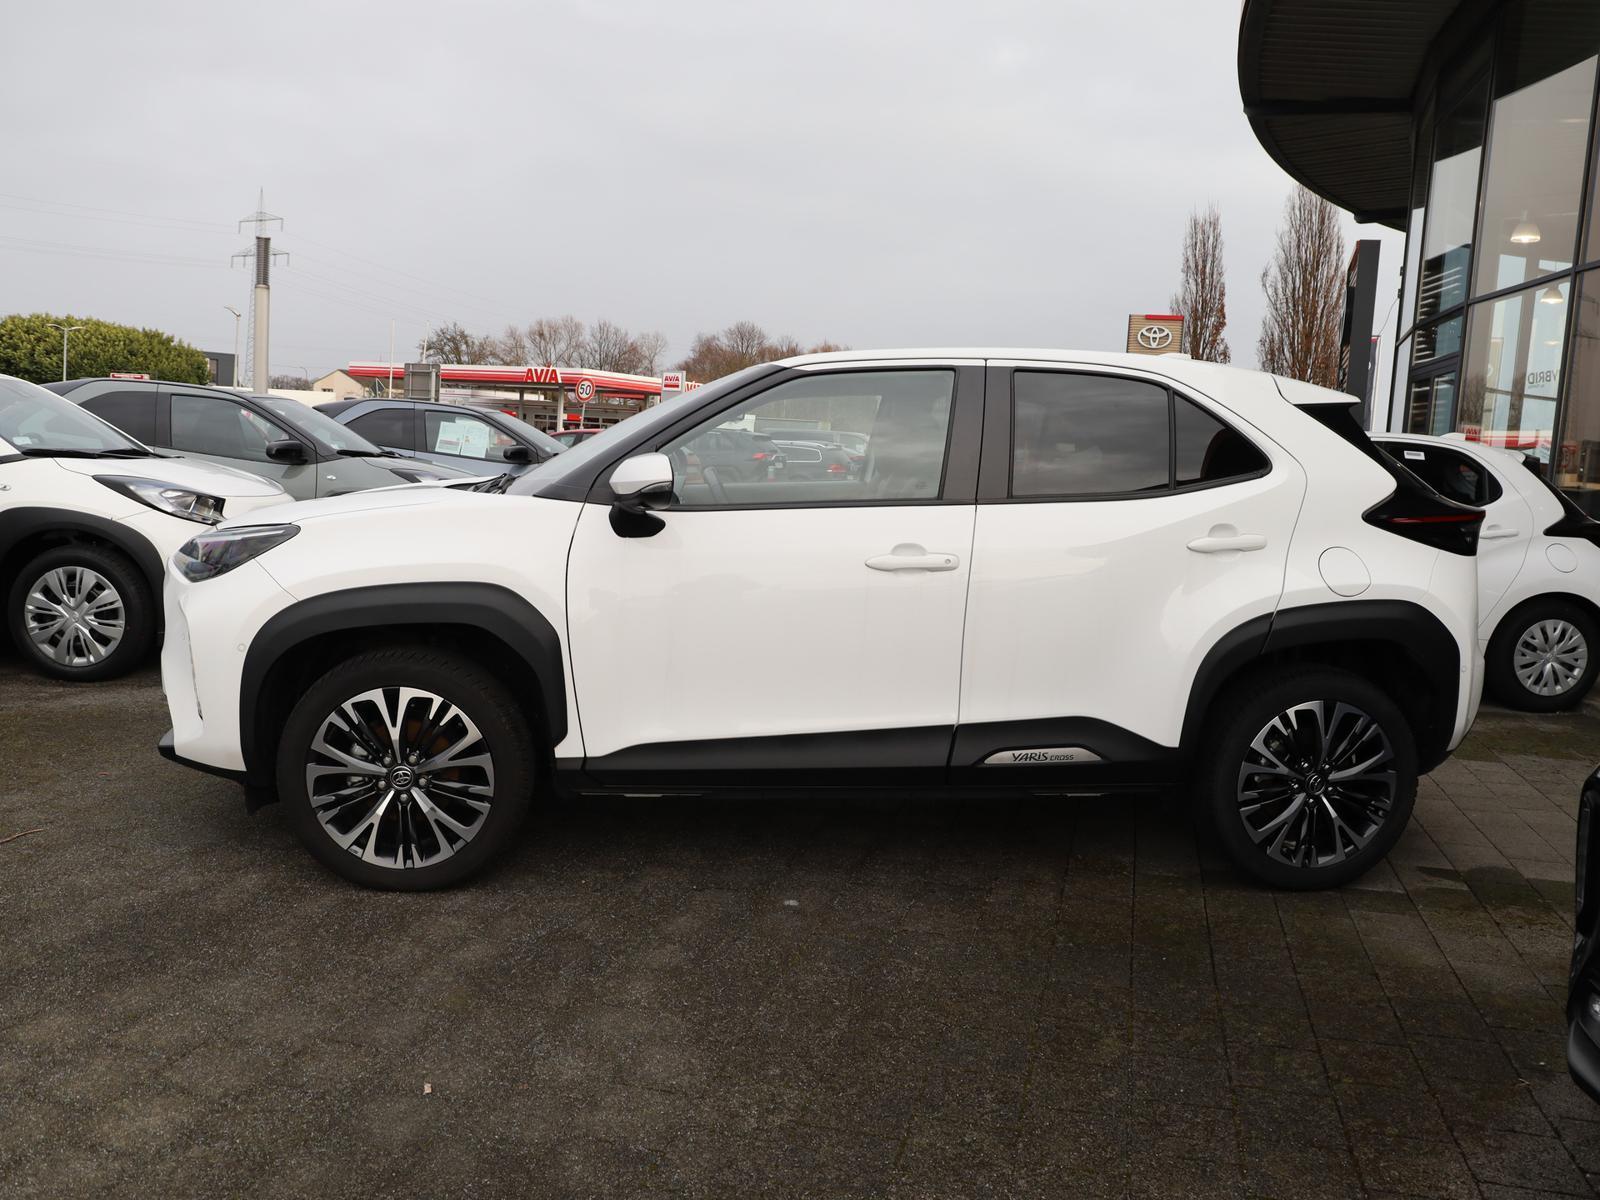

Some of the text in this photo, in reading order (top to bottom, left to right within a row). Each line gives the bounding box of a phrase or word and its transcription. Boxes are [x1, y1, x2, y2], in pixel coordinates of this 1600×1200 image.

[525, 366, 560, 383] AVIA
[664, 374, 680, 382] AVIA
[579, 383, 592, 396] 50
[1012, 752, 1049, 762] YARIS
